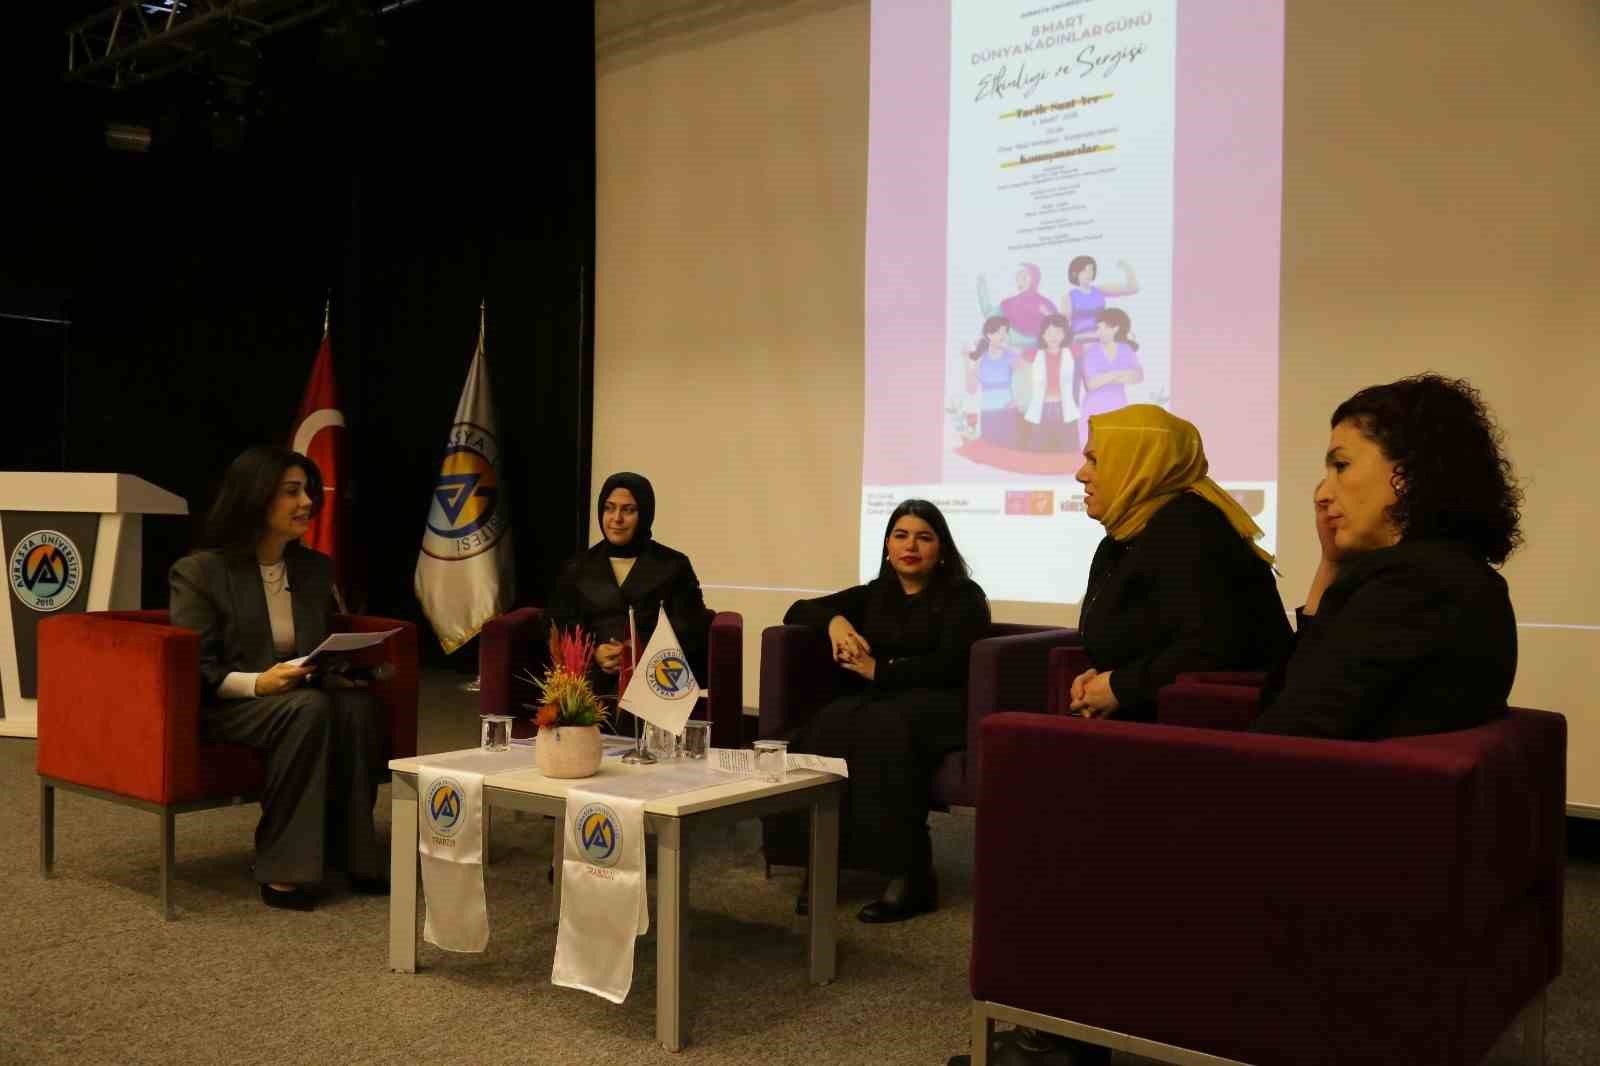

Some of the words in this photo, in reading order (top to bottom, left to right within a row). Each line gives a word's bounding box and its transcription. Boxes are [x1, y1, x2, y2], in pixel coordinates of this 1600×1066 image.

[1023, 25, 1104, 52] KADINLAR
[1104, 9, 1153, 34] GÜNÜ
[1041, 15, 1084, 34] MART
